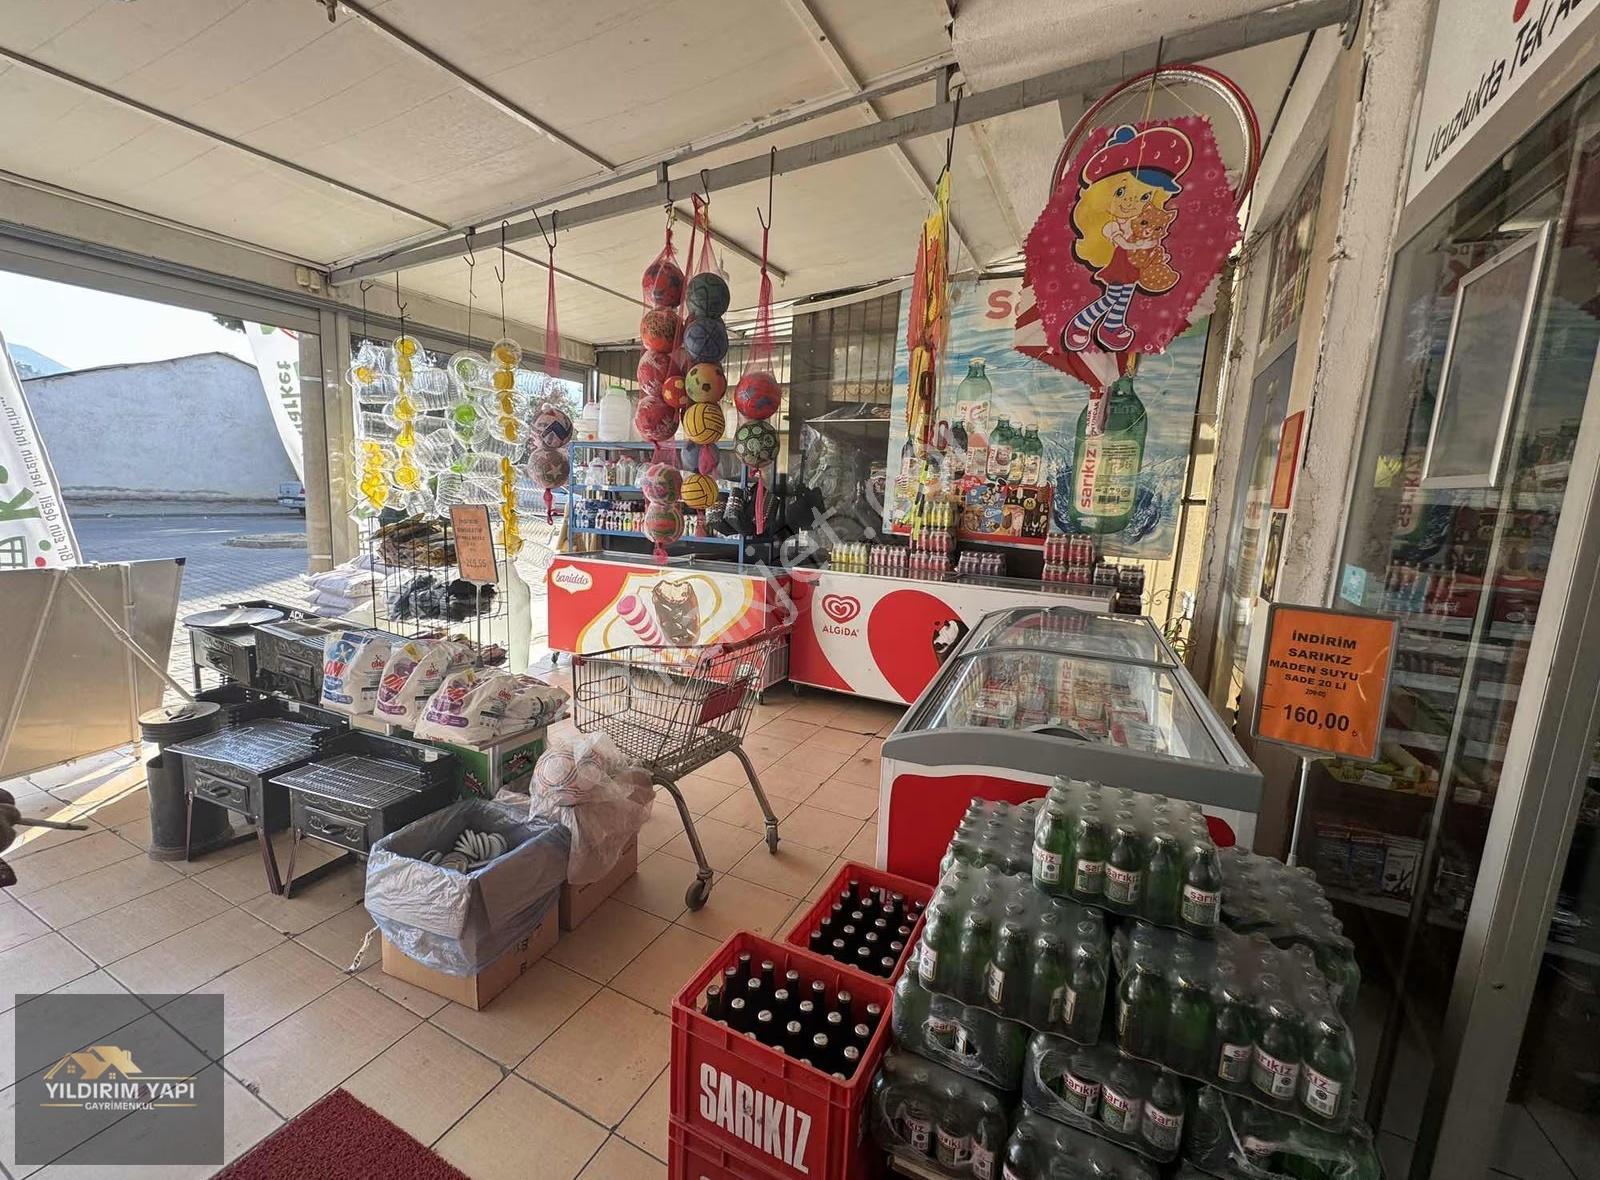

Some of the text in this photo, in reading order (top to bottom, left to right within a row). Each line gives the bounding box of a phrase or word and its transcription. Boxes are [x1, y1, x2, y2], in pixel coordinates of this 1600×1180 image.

[1424, 59, 1507, 173] Ucuzlukta
[1292, 630, 1357, 649] İNDİRİM
[1288, 648, 1353, 666] SARIKIZ
[1269, 659, 1359, 681] MADEN SUYU
[1284, 673, 1316, 686] SADE
[1318, 679, 1332, 688] 20
[1283, 703, 1350, 732] 160,00
[700, 1062, 812, 1175] SARIKIZ
